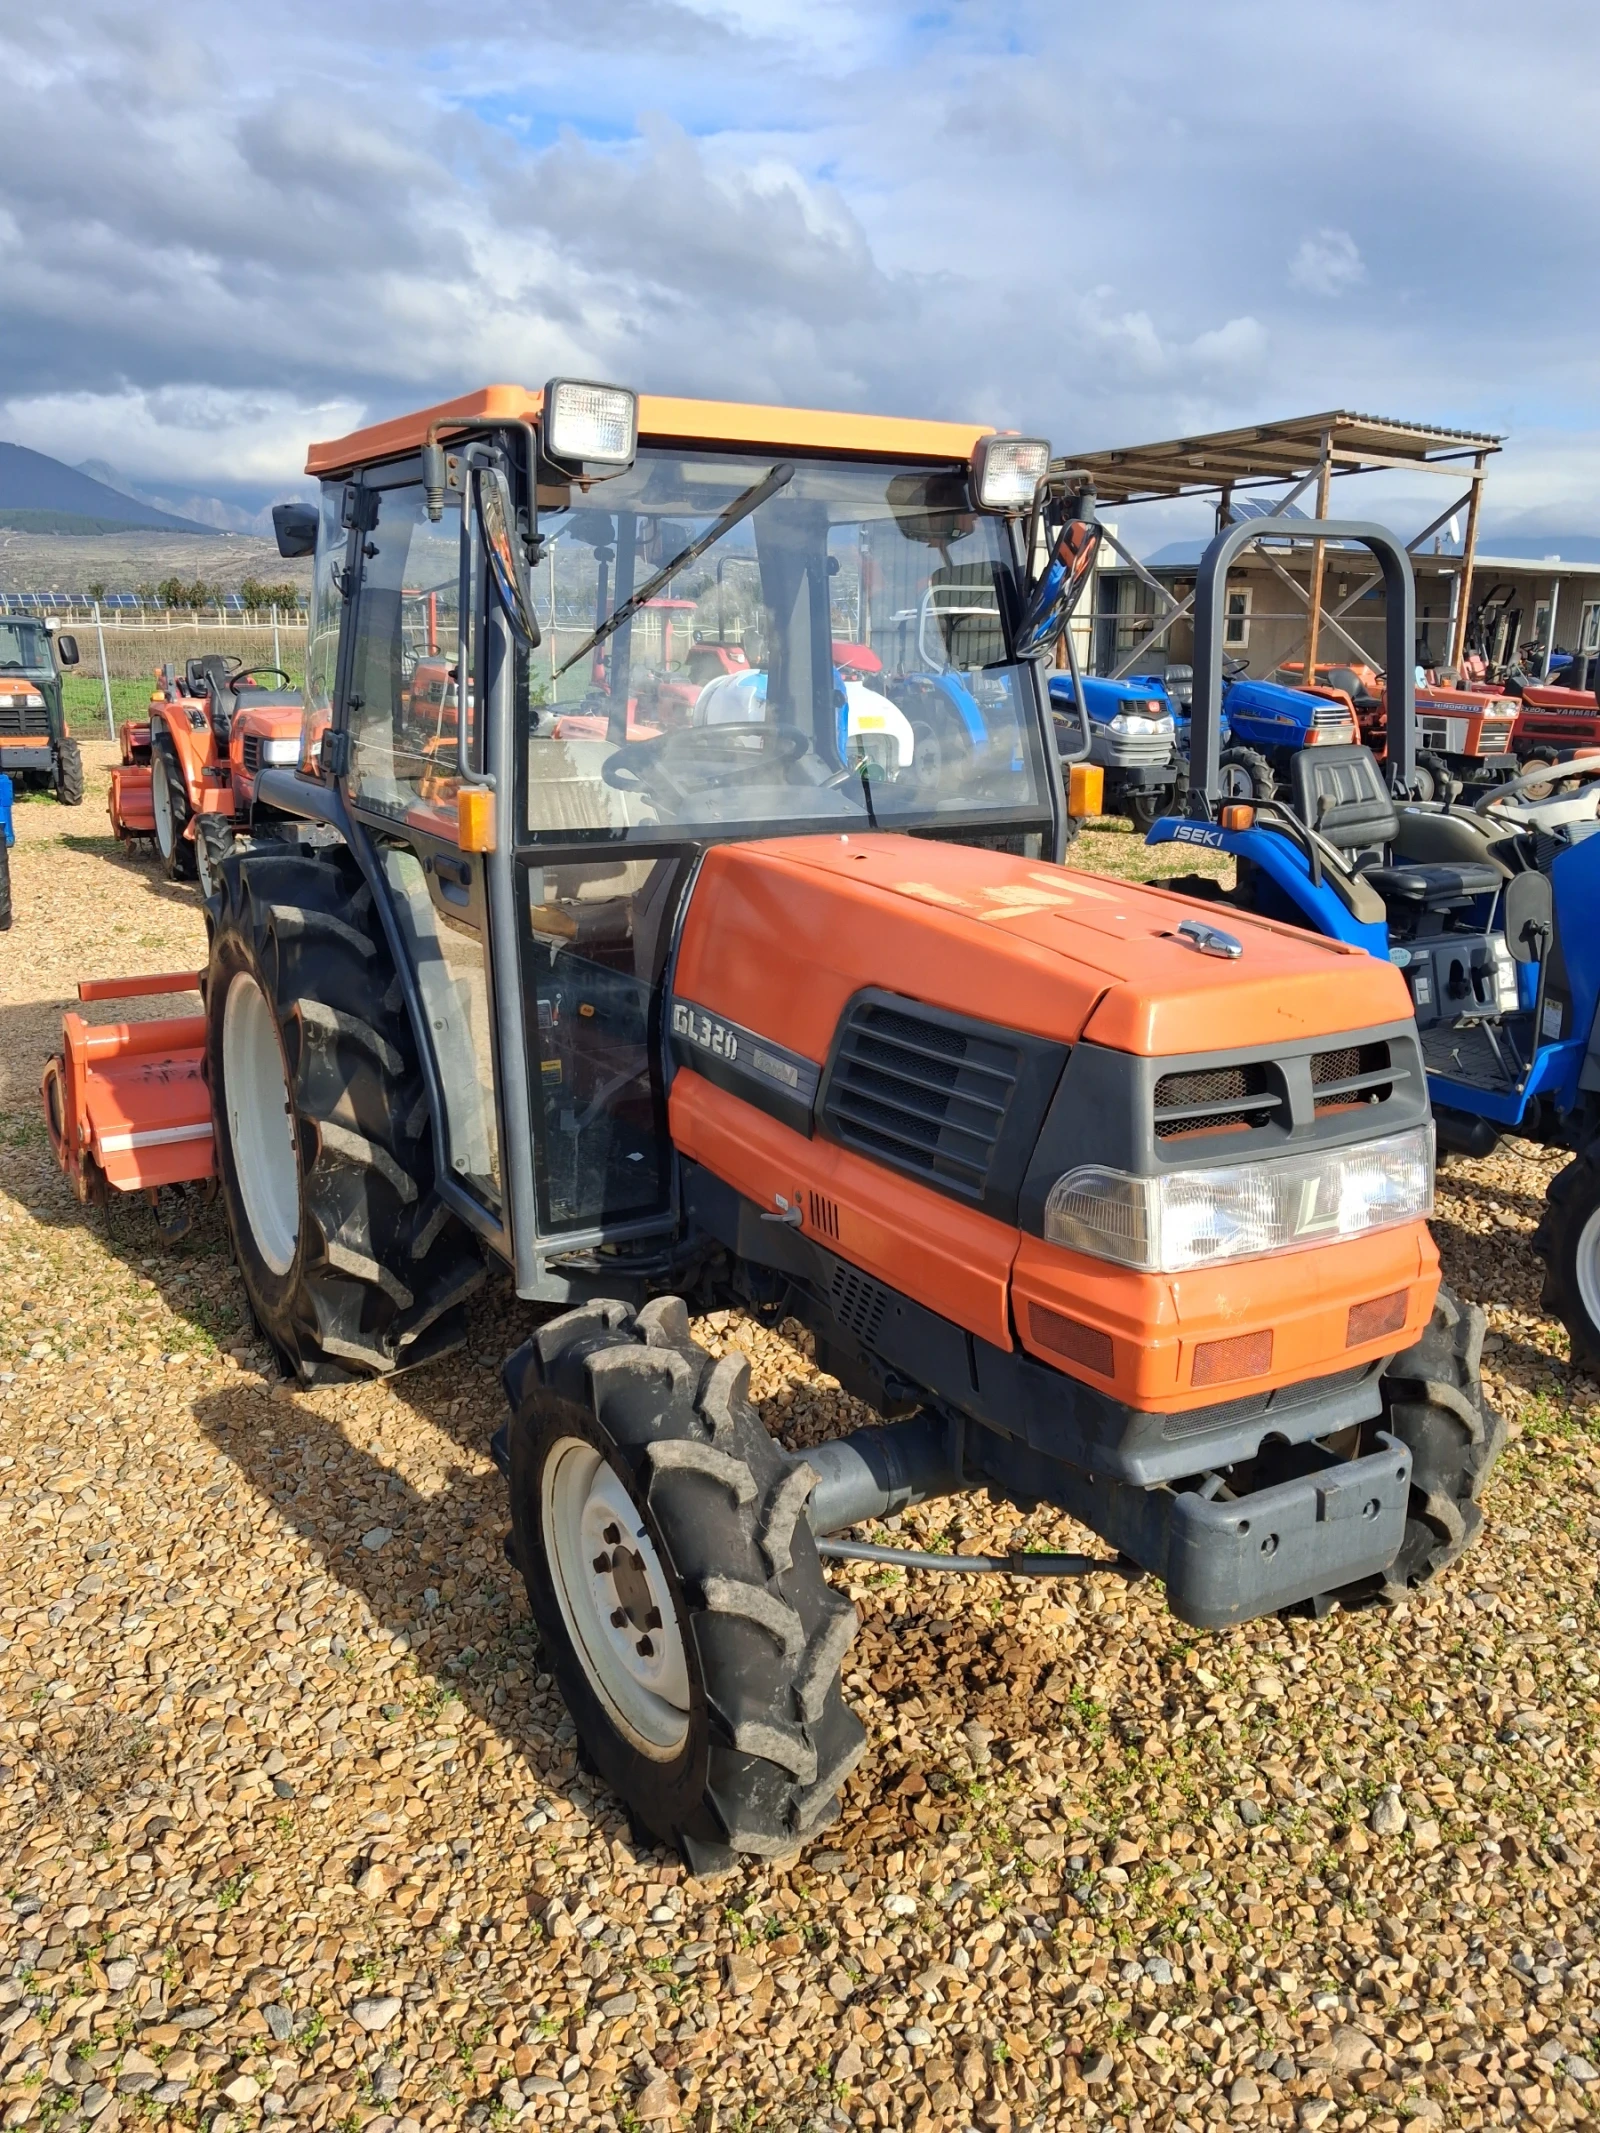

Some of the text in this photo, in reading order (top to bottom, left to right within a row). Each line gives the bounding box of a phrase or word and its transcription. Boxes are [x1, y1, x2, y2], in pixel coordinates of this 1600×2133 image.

[1434, 703, 1480, 712] HINOMOTO
[1556, 708, 1598, 717] YANMAR
[1173, 825, 1224, 847] ISEKI
[673, 1003, 738, 1060] GL320
